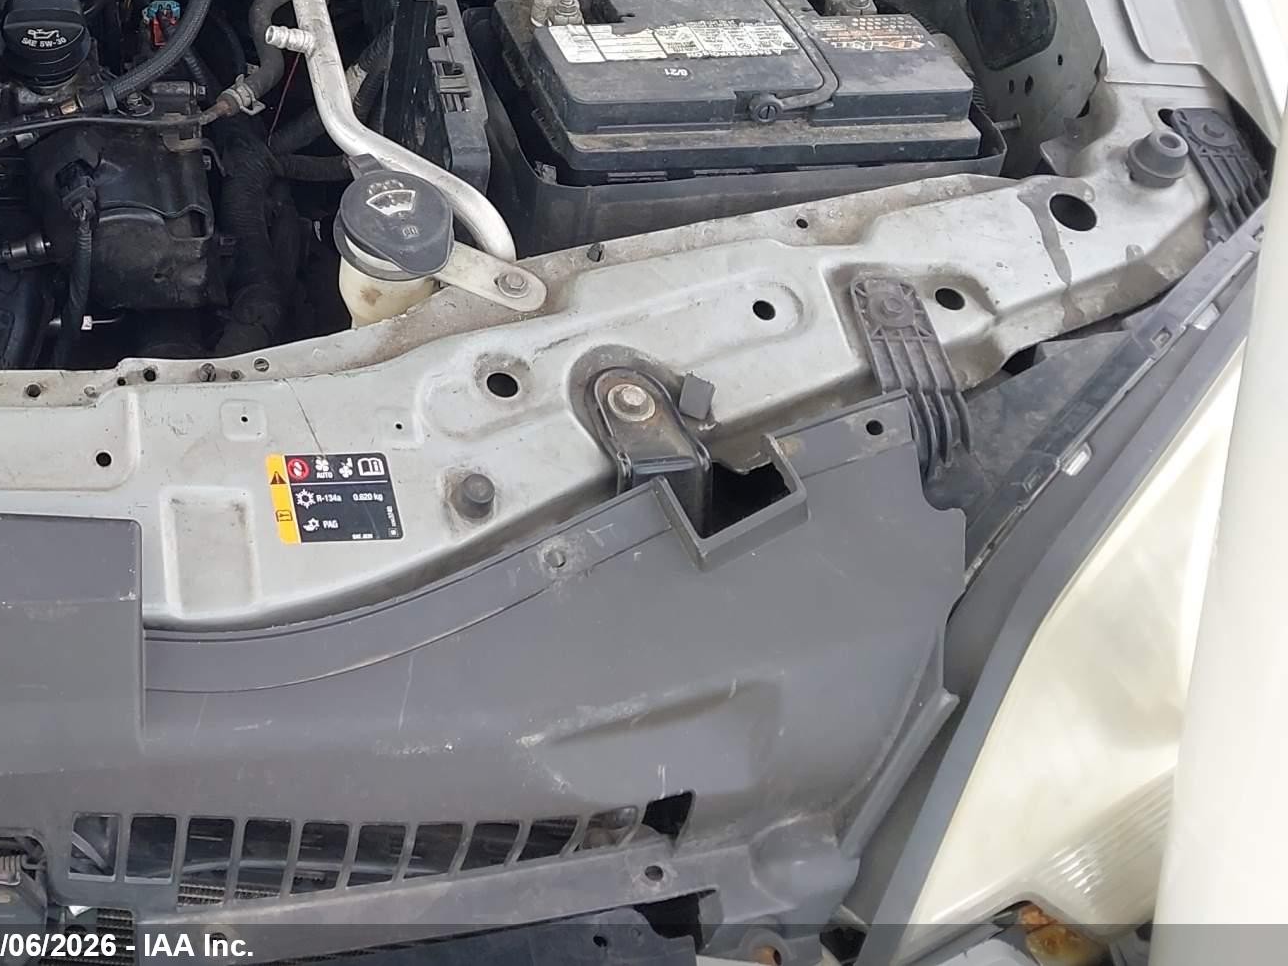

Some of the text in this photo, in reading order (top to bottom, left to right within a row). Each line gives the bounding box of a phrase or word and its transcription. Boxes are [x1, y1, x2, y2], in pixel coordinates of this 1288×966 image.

[21, 37, 66, 47] SAE 5W-30
[316, 494, 342, 502] R-134a
[322, 520, 339, 529] PAG
